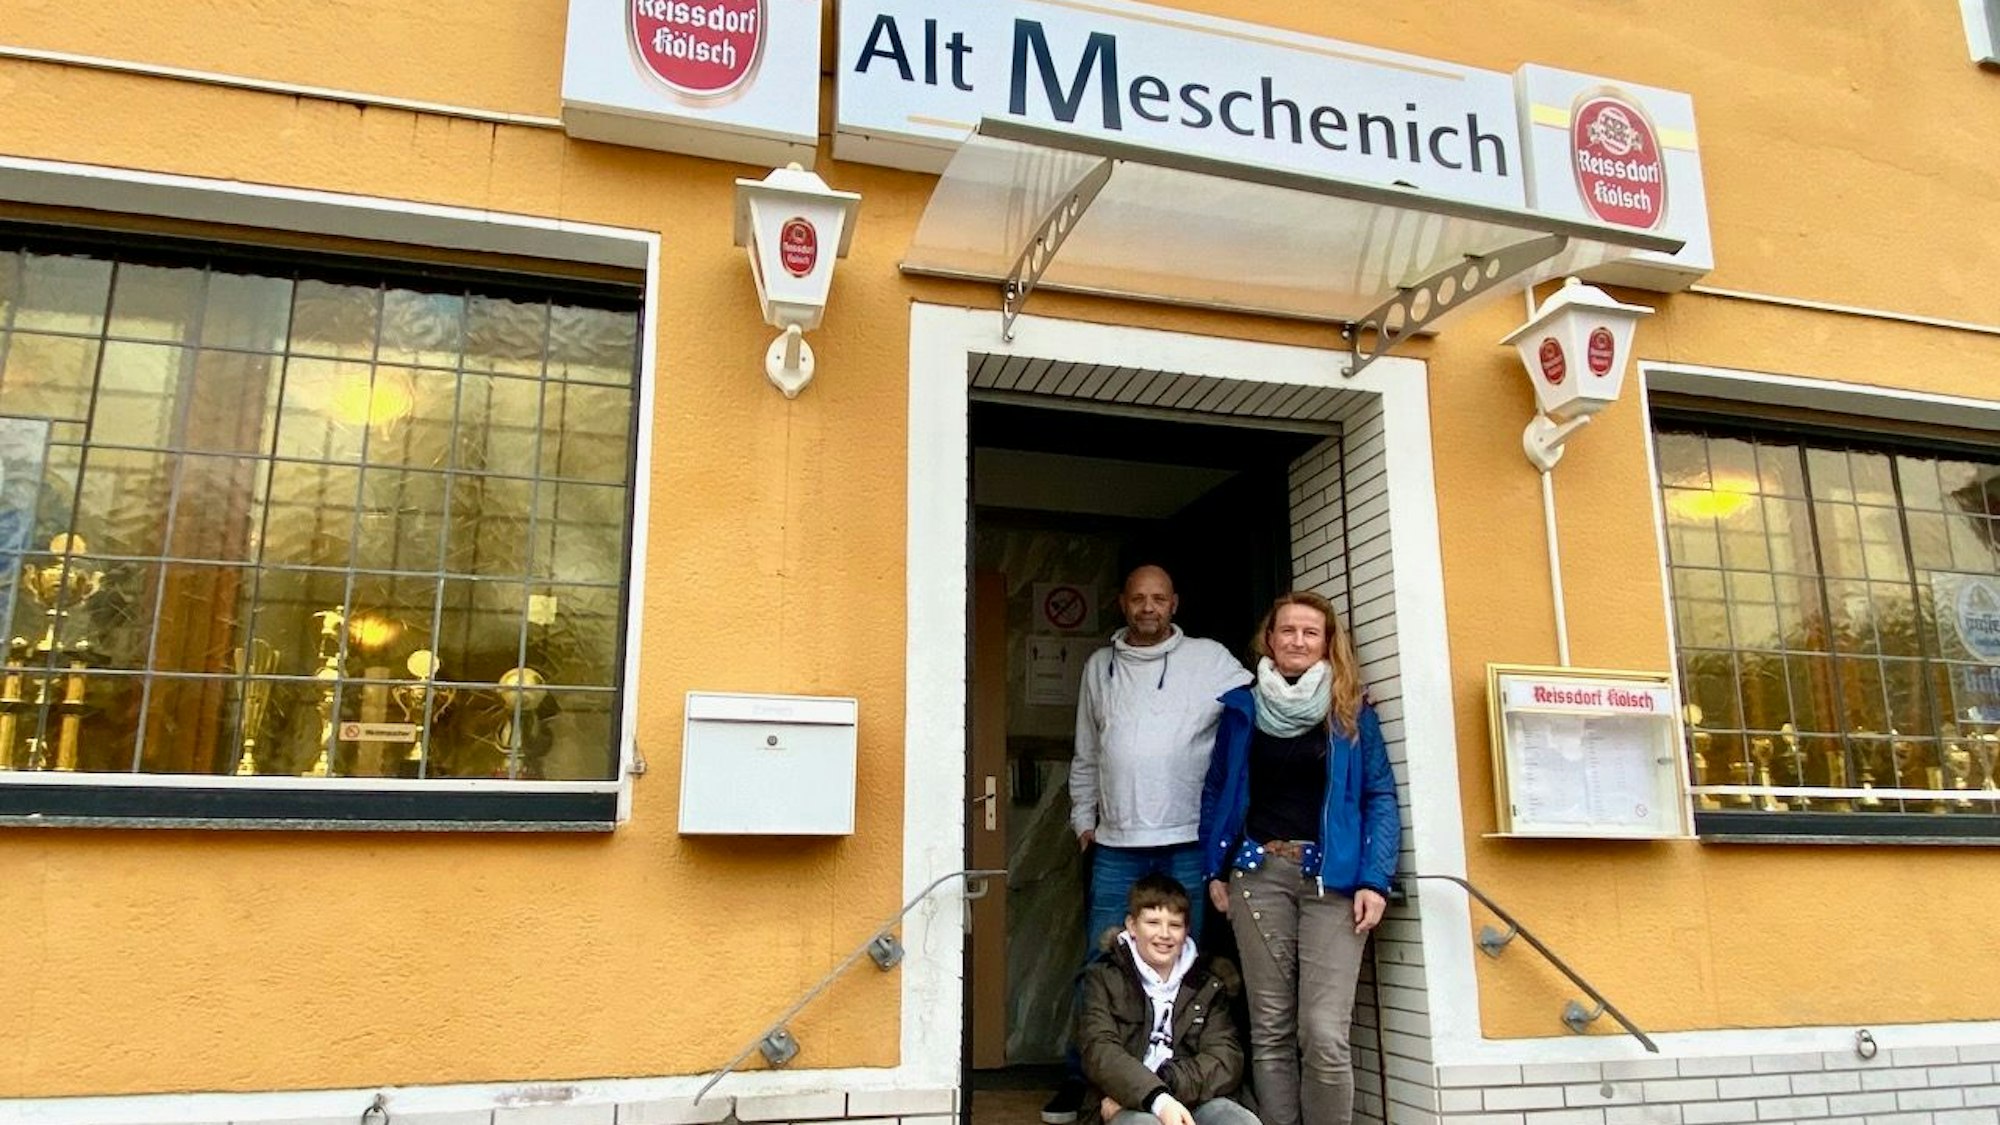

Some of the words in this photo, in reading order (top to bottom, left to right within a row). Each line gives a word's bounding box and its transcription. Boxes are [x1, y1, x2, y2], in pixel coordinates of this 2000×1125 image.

[652, 26, 736, 69] Kölsch
[855, 14, 974, 92] Alt
[1009, 17, 1508, 177] Meschenich
[1579, 149, 1660, 183] Reissdorf
[1595, 180, 1652, 213] Kölsch
[1534, 685, 1602, 706] Reissdorf
[1608, 688, 1654, 711] Kölsch
